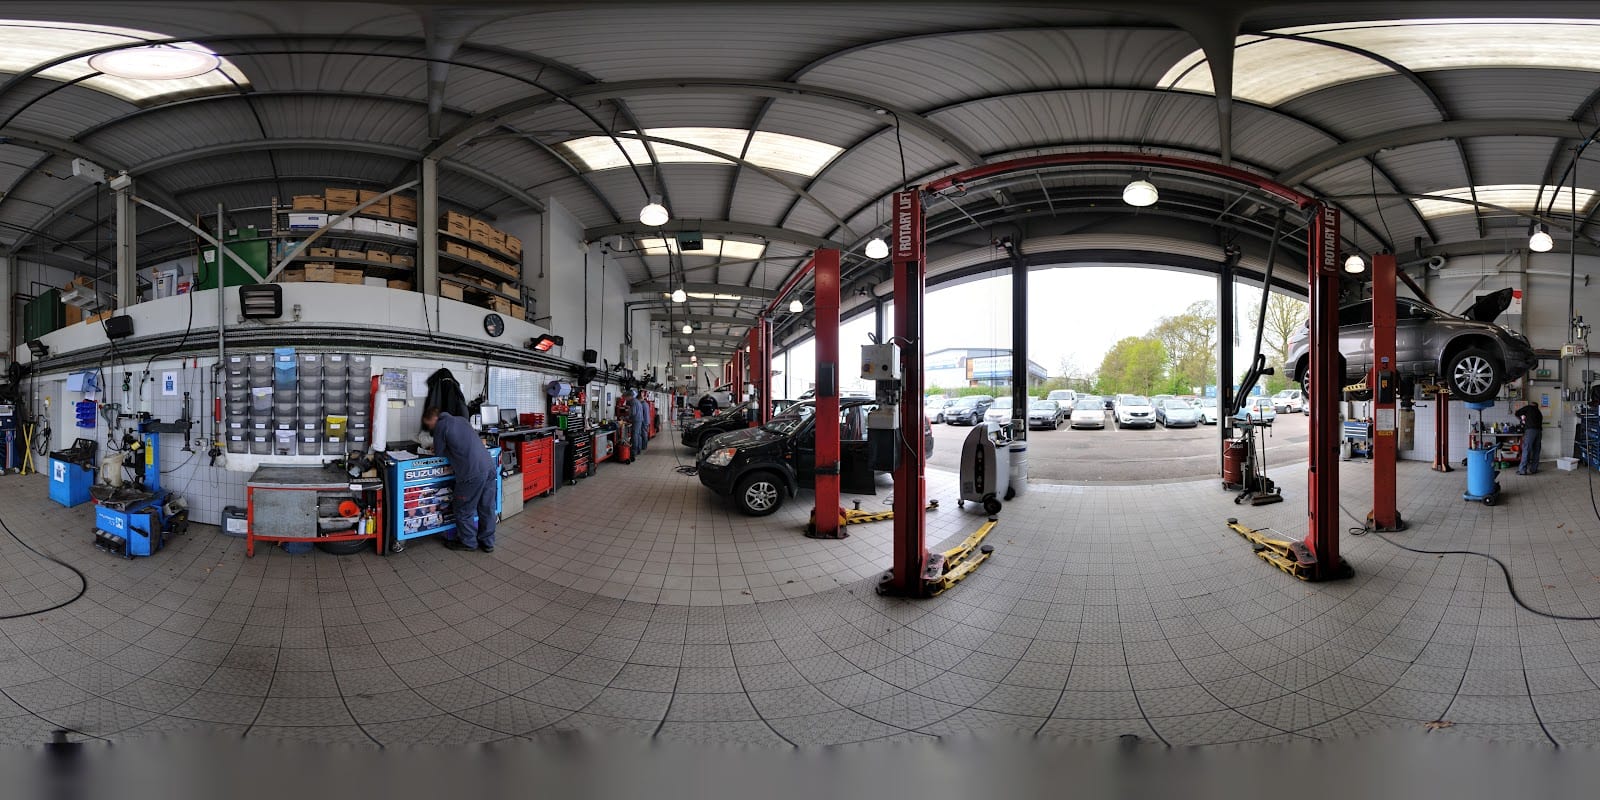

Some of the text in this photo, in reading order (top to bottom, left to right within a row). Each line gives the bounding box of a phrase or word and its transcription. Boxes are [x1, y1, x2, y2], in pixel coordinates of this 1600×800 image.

[899, 212, 911, 251] ROTARY
[1324, 227, 1335, 266] ROTARY
[406, 467, 444, 479] SUZUKI
